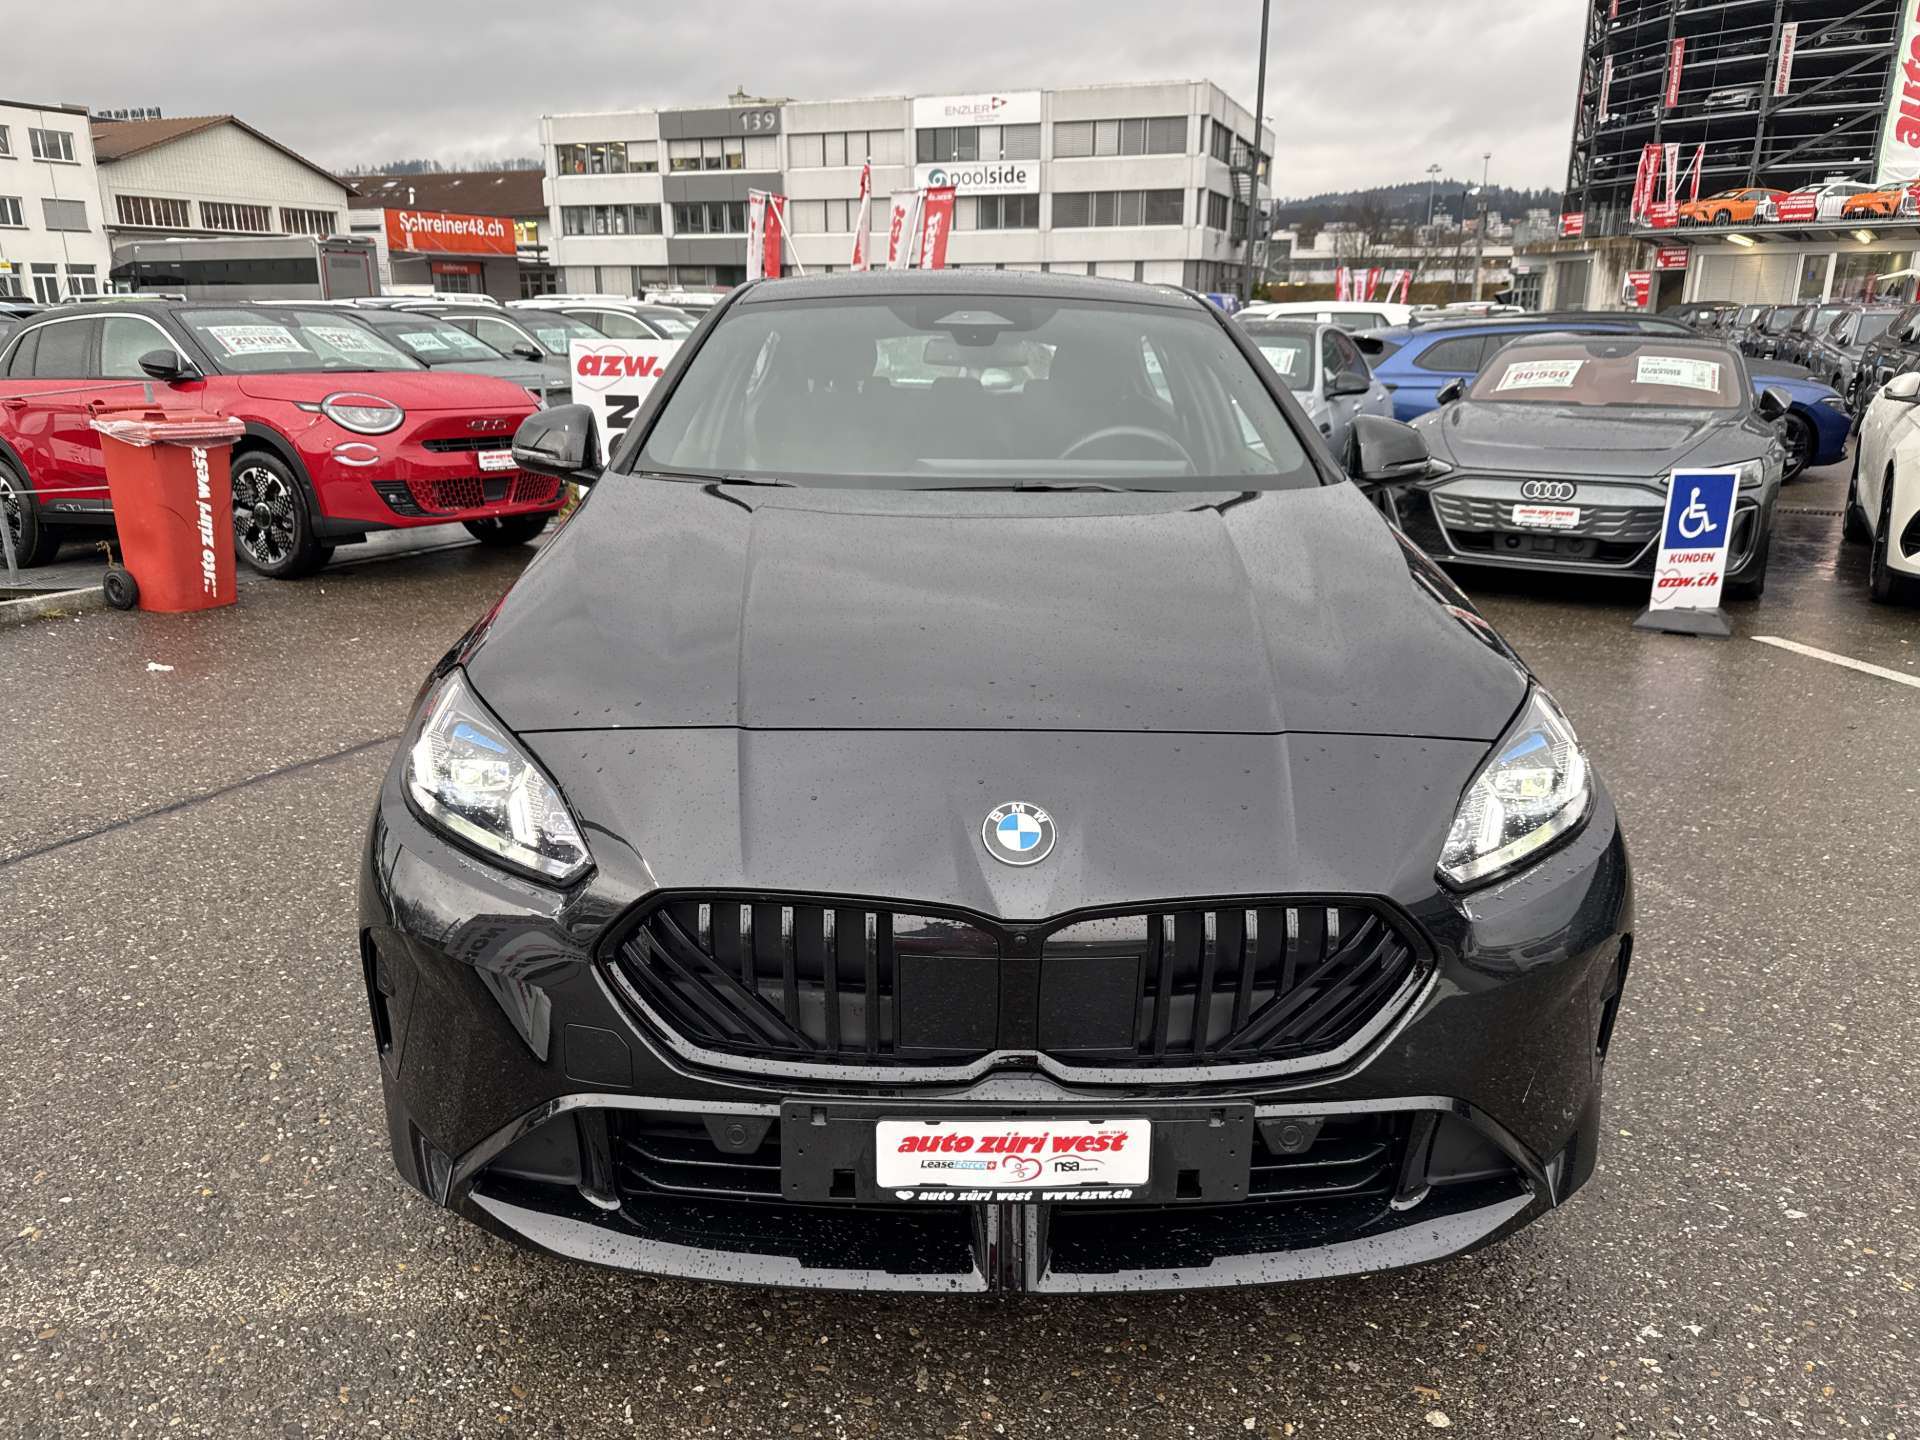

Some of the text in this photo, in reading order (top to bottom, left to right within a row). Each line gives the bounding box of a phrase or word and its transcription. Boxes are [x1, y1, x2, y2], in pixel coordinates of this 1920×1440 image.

[944, 104, 990, 116] ENZLER
[739, 111, 776, 131] 139
[950, 165, 1027, 187] poolside
[399, 211, 505, 238] Schreiner48.ch
[577, 355, 664, 378] azw.
[1669, 552, 1716, 564] KUNDEN
[1657, 571, 1719, 588] azw.ch
[989, 803, 1049, 824] BMW
[898, 1131, 1129, 1154] auto züri west
[920, 1159, 986, 1171] LeaseForce
[1054, 1161, 1080, 1173] nsa
[918, 1188, 1133, 1201] auto züri west www.azw.ch
